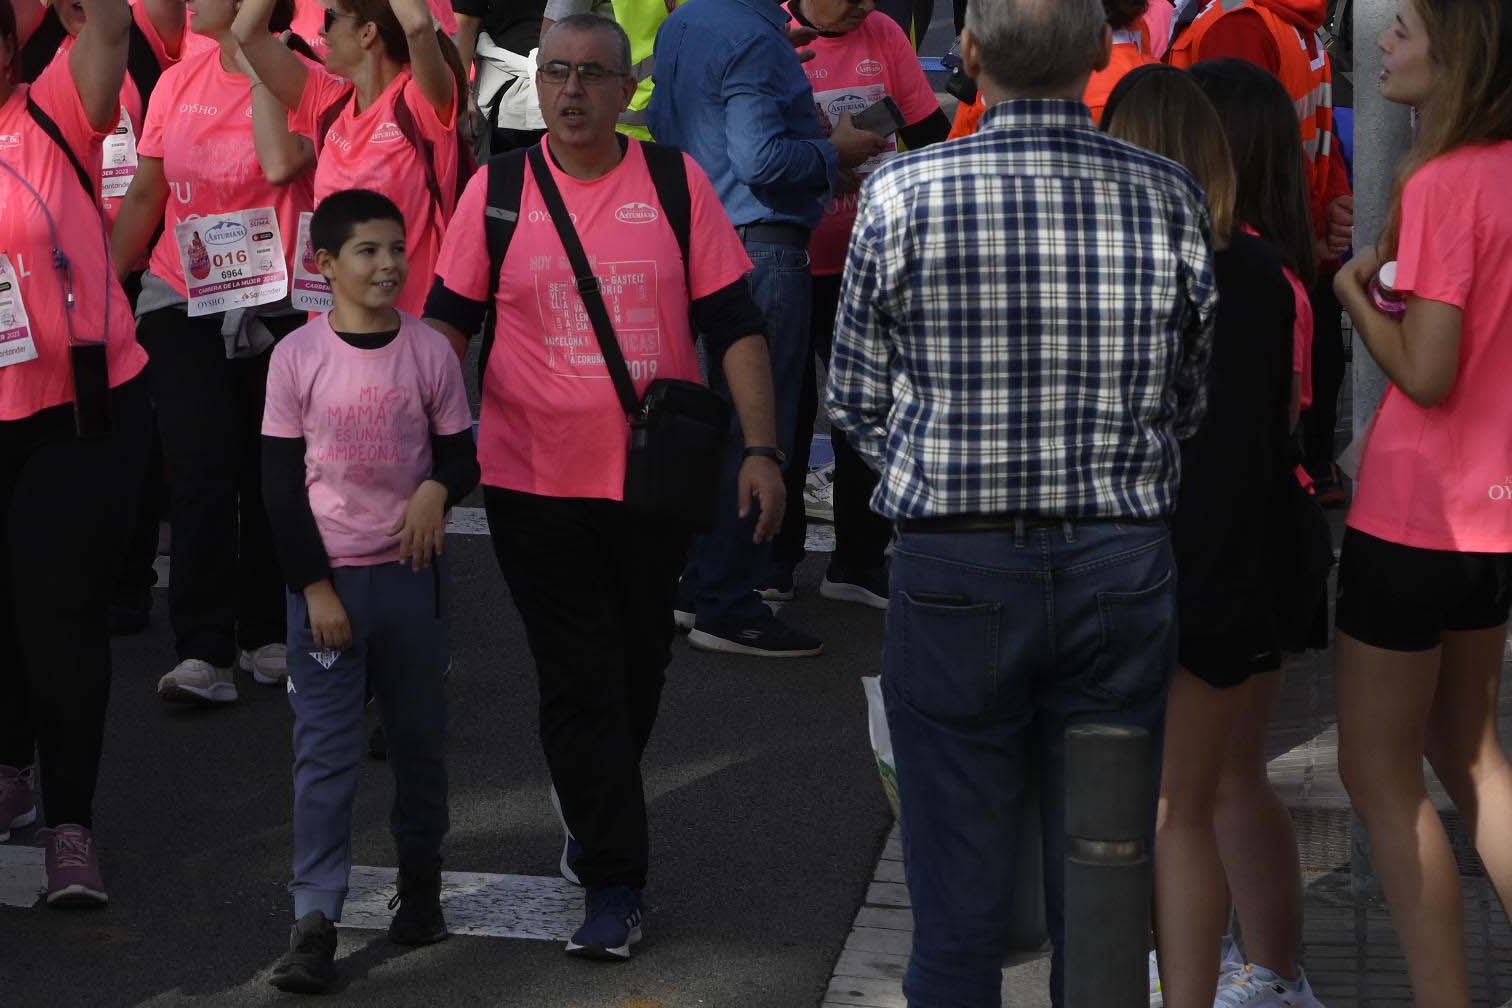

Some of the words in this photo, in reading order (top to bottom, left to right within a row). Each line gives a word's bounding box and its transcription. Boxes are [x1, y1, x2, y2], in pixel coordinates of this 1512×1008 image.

[179, 103, 218, 116] OYSHO
[206, 230, 245, 243] ASTURIANA
[212, 249, 248, 268] 016
[221, 268, 243, 280] 6964
[198, 284, 223, 295] CARRERA
[223, 282, 232, 290] DE
[240, 277, 262, 287] MUJER
[197, 297, 226, 310] OYSHO
[335, 428, 353, 442] ES
[355, 428, 383, 442] UNA
[316, 444, 400, 463] CAMPEONA
